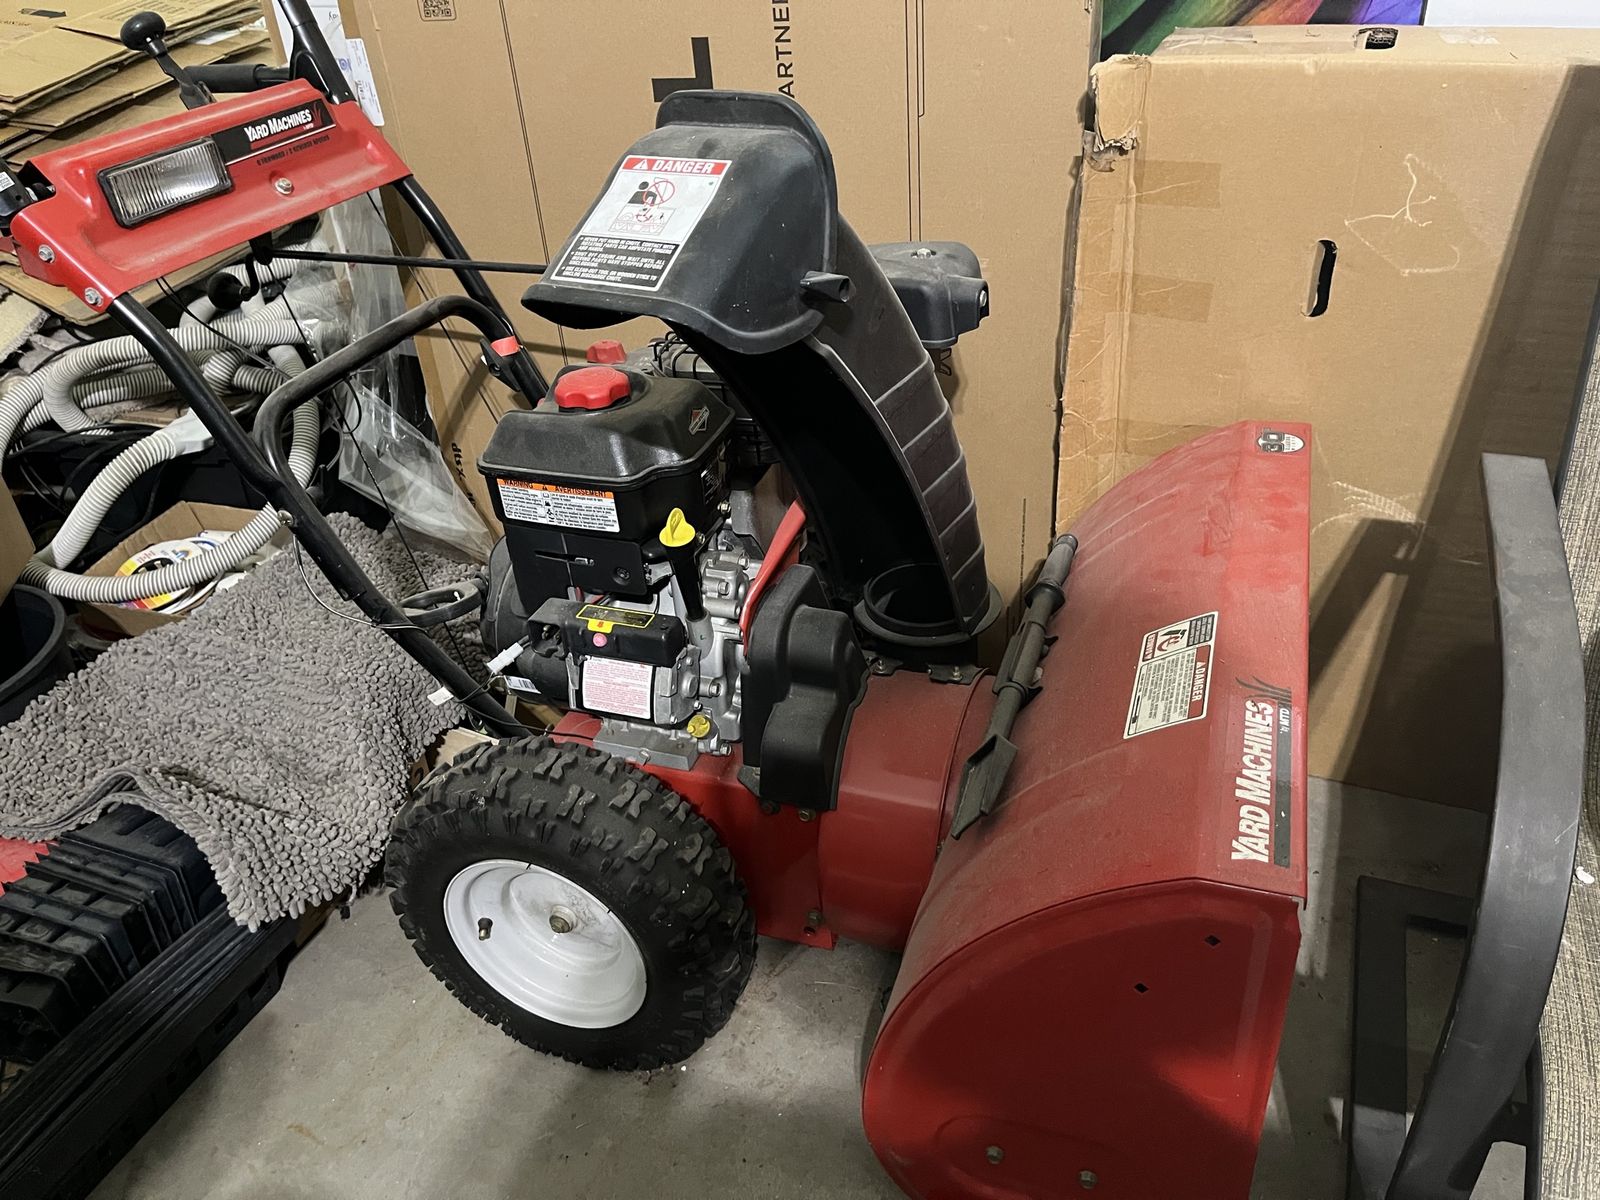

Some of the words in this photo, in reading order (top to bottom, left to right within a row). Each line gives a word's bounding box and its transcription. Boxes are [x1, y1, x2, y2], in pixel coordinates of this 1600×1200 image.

[244, 124, 270, 142] YARD
[268, 109, 312, 134] MACHINES
[652, 159, 715, 174] DANGER
[1191, 666, 1206, 702] DANGER
[1279, 707, 1290, 725] MTD
[1235, 700, 1274, 805] MACHINES
[1231, 804, 1271, 863] YARD
